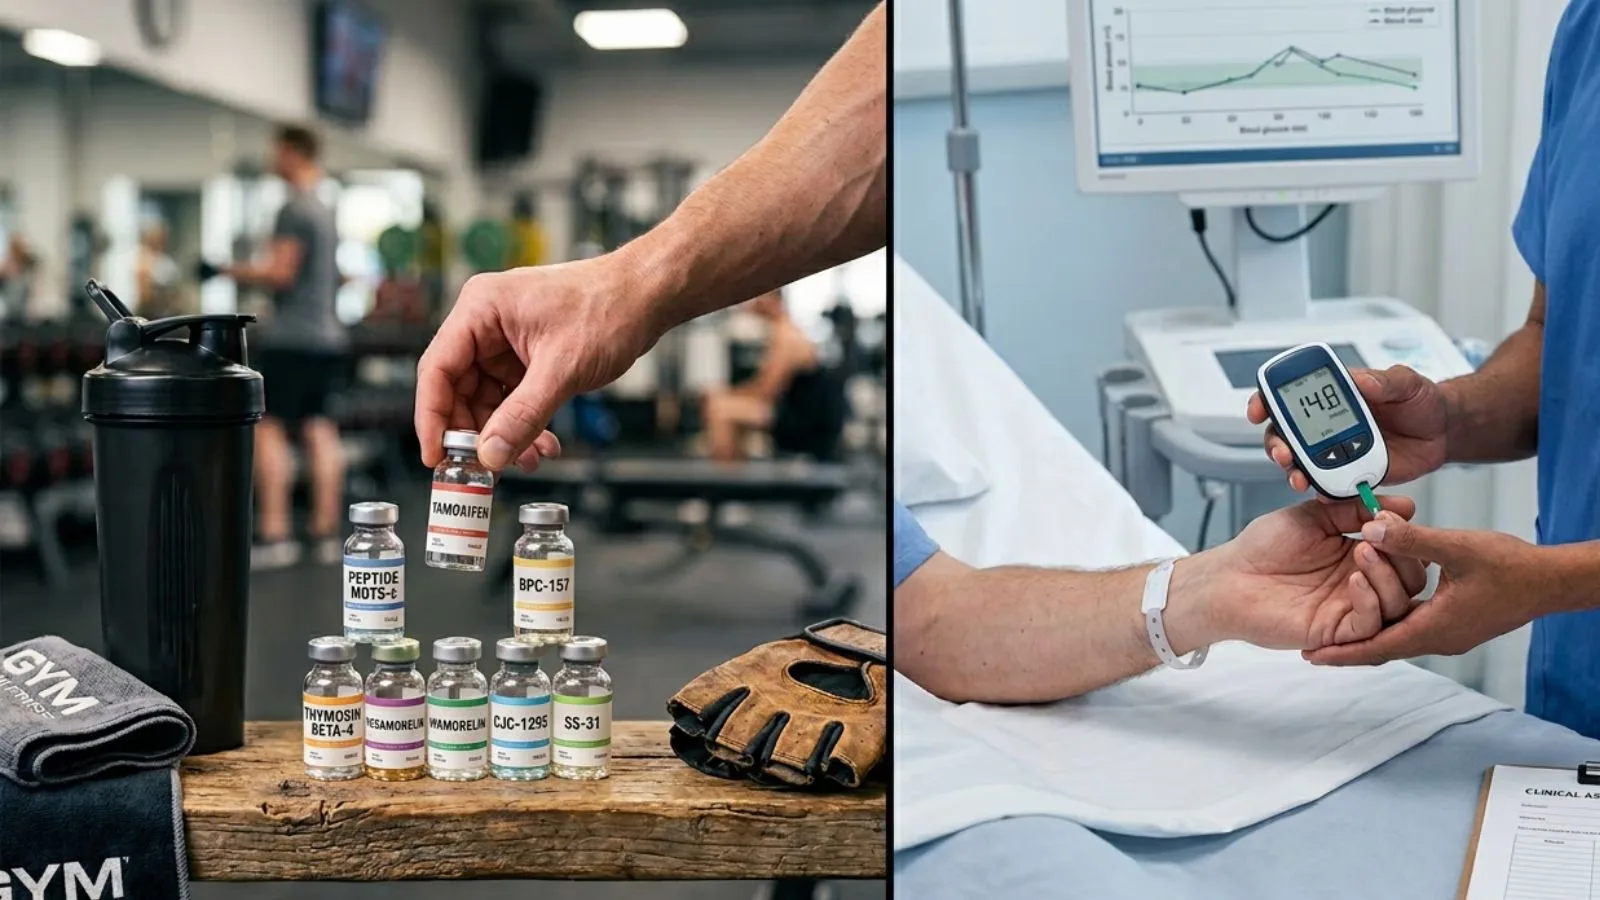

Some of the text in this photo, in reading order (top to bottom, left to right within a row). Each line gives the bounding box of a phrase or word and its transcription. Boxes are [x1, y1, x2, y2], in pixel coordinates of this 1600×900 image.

[432, 501, 489, 519] TAMOAIFEN
[348, 570, 399, 585] PEPTIDE
[519, 577, 570, 592] BPC-157
[3, 649, 99, 716] GYM
[304, 706, 361, 722] THYMOSIN
[311, 722, 354, 737] BETA-4
[493, 715, 548, 730] CJC-1295
[564, 715, 600, 730] SS-31
[1525, 788, 1580, 798] CLINICAL
